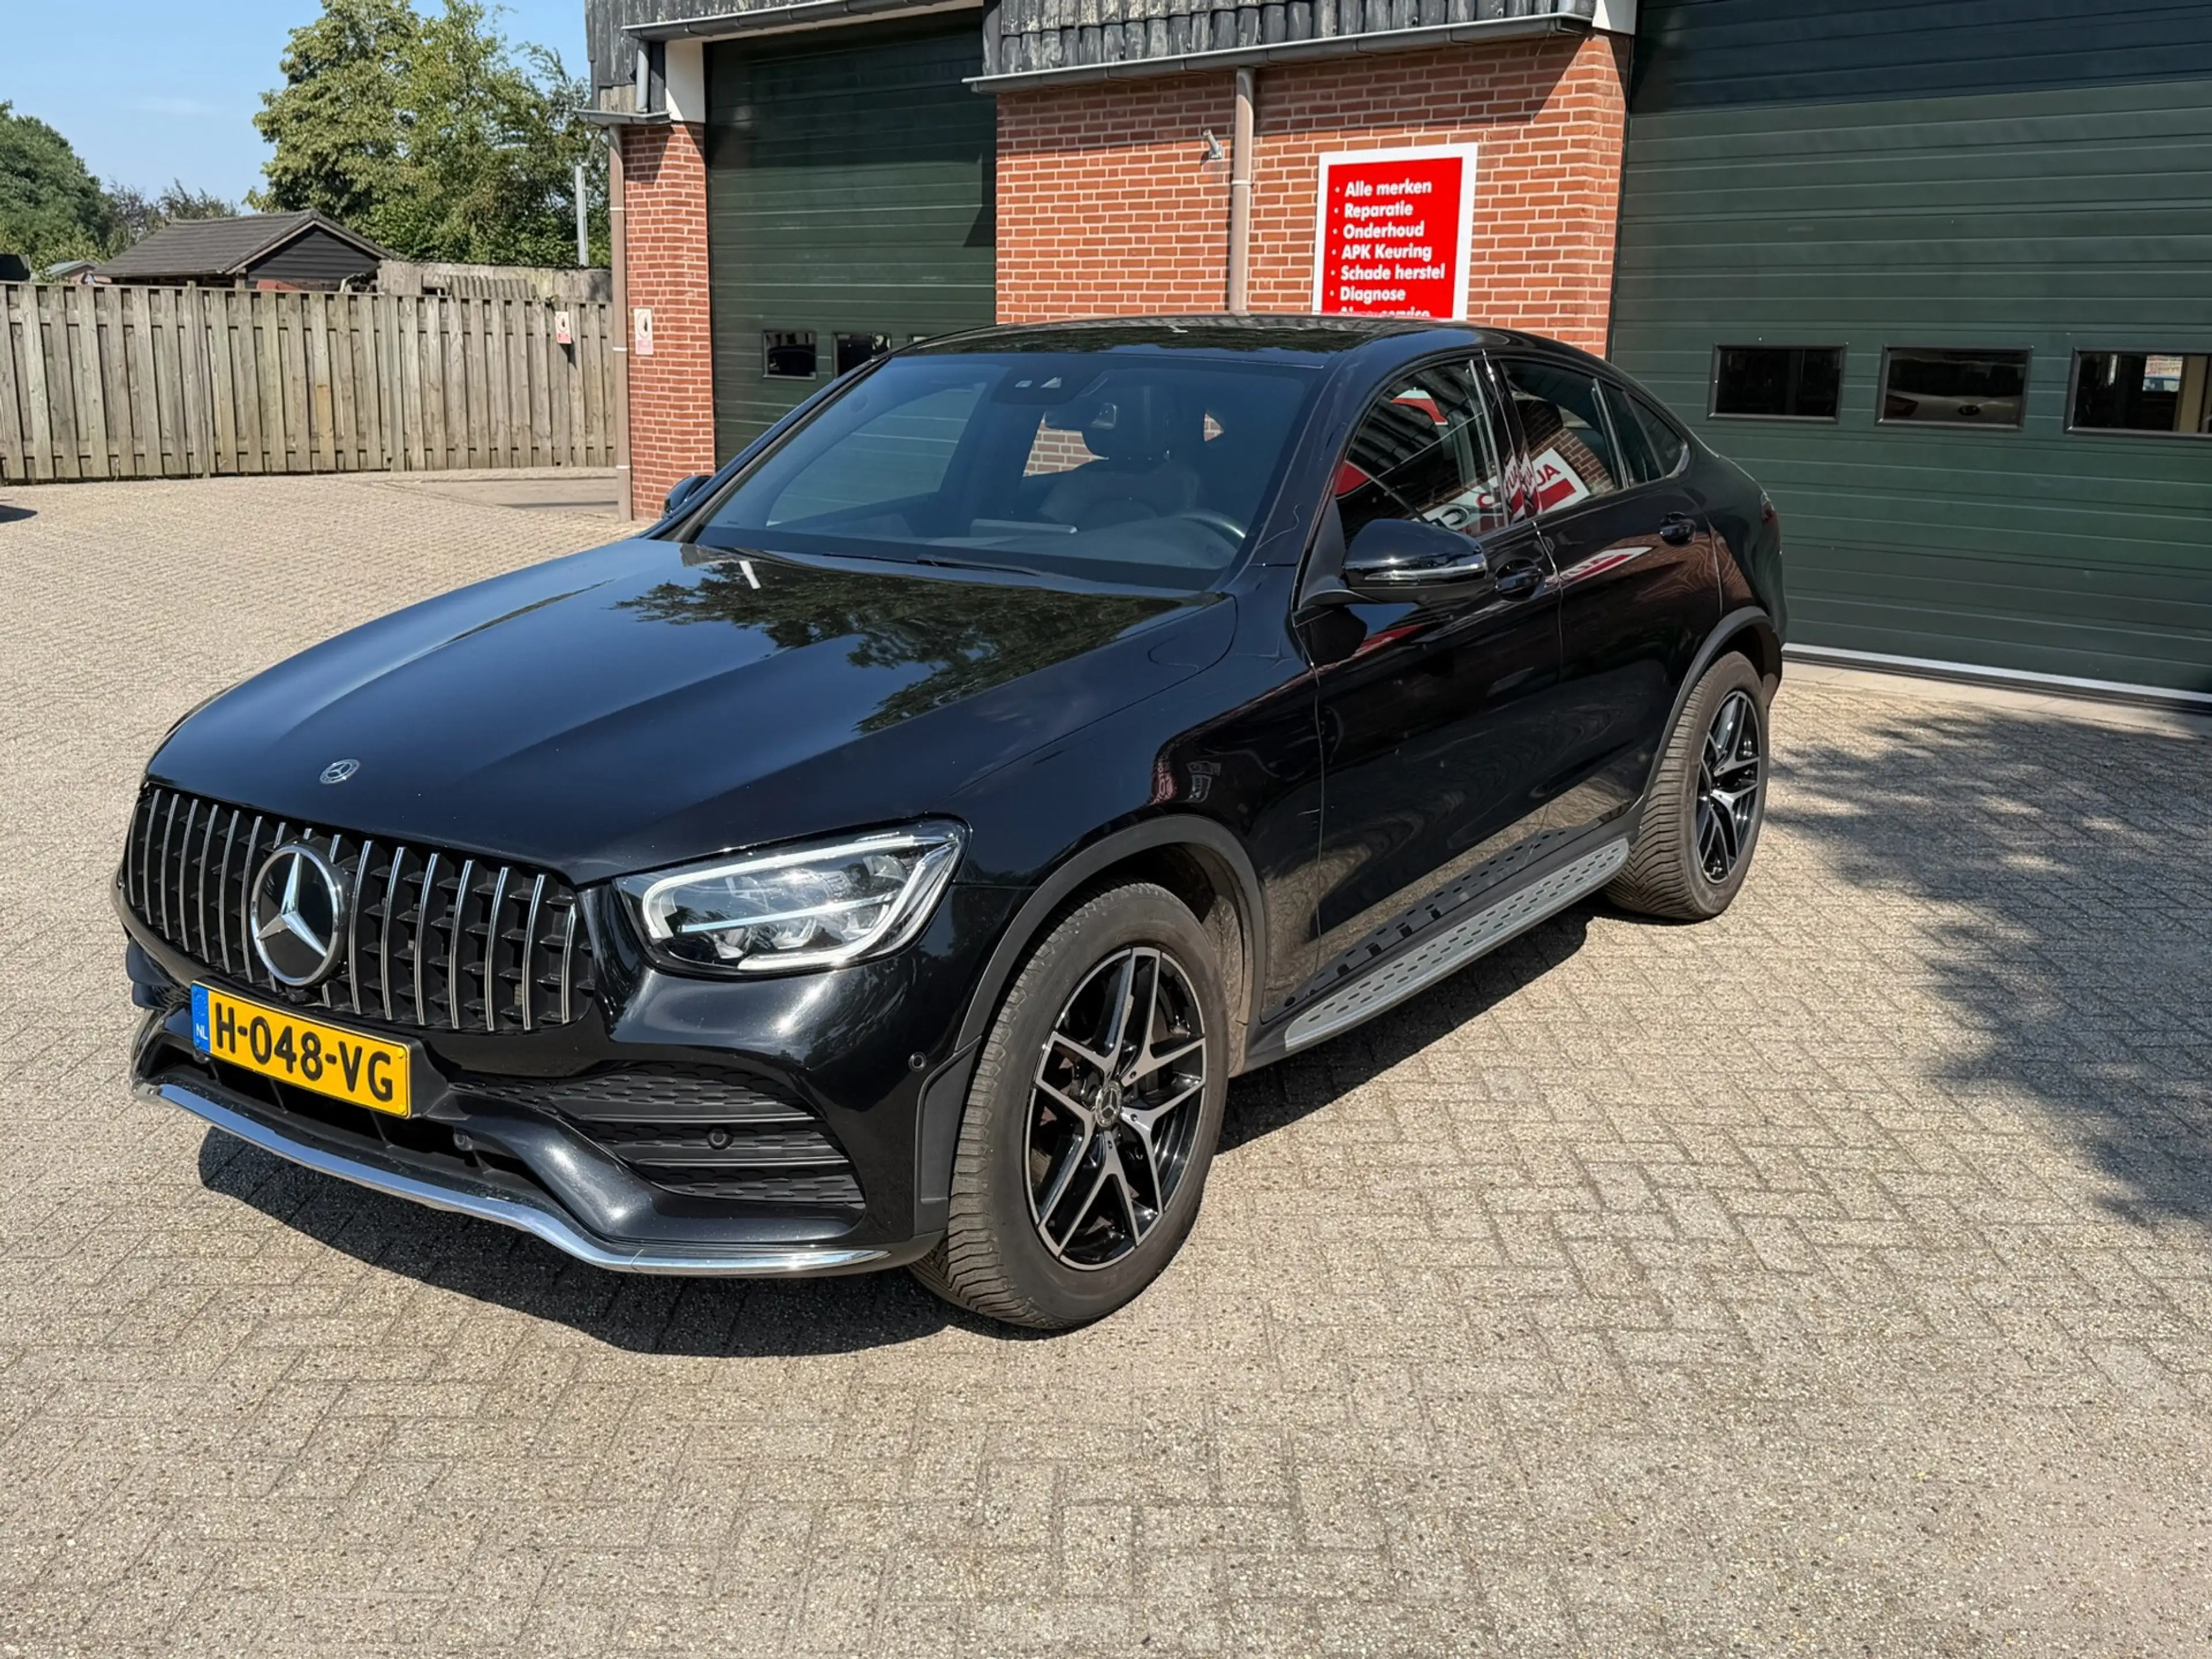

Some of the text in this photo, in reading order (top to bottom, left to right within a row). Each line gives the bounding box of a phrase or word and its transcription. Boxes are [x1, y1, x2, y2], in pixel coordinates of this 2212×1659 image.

[1344, 177, 1432, 197] Alle merken
[1344, 200, 1414, 221] Reparatie
[1343, 220, 1425, 240] Onderhoud
[1341, 243, 1433, 262] APK Keuring
[1340, 263, 1446, 281] Schade herstel
[1340, 285, 1406, 305] Diagnose
[196, 1023, 208, 1041] NL
[215, 1002, 393, 1103] H-048-VG
